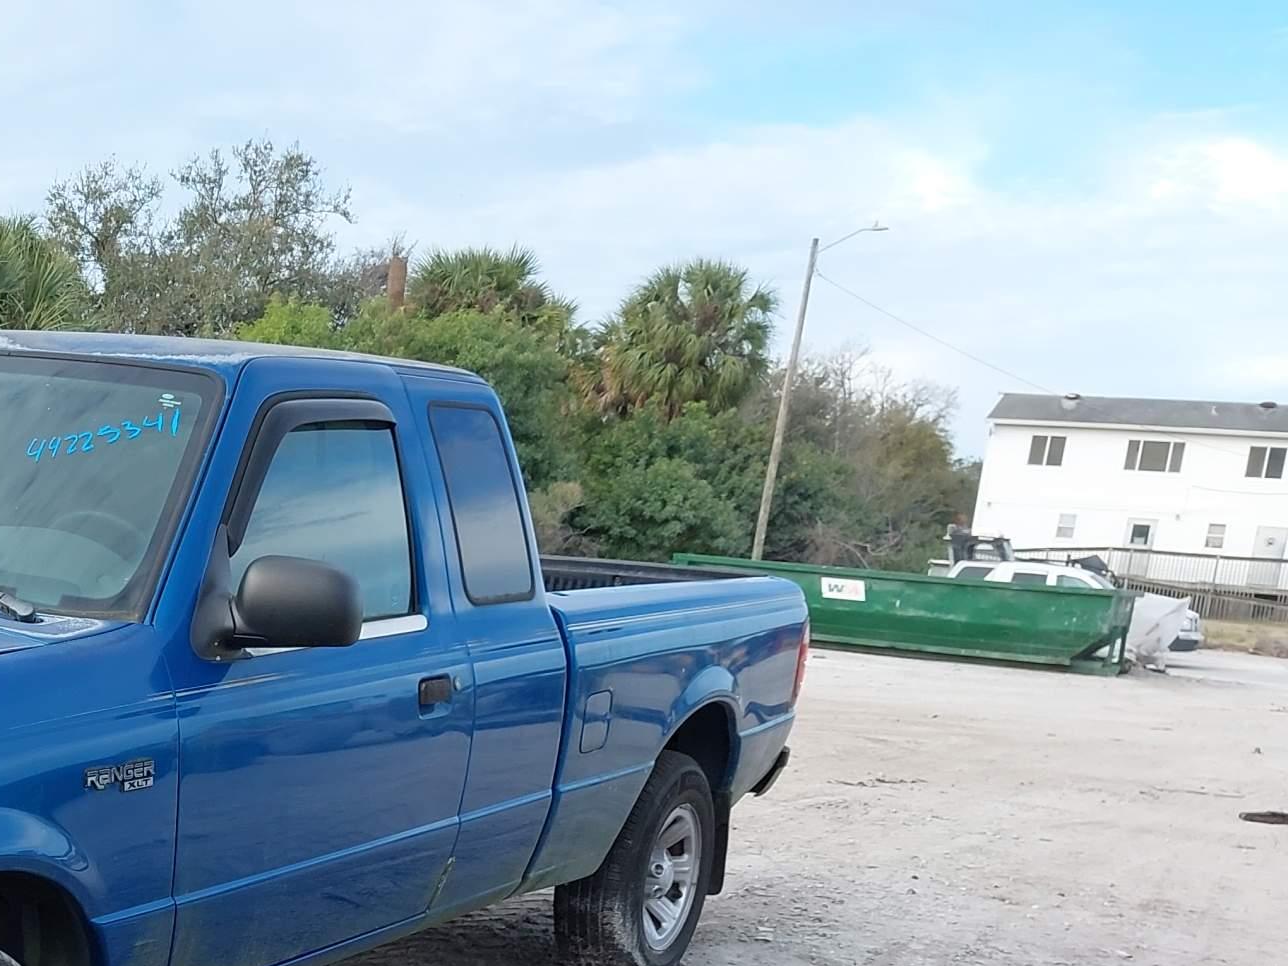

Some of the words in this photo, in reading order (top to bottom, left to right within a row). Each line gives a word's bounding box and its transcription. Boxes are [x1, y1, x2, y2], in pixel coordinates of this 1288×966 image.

[26, 408, 181, 462] 44225341
[86, 760, 155, 790] RANGER
[126, 778, 151, 790] XLT
